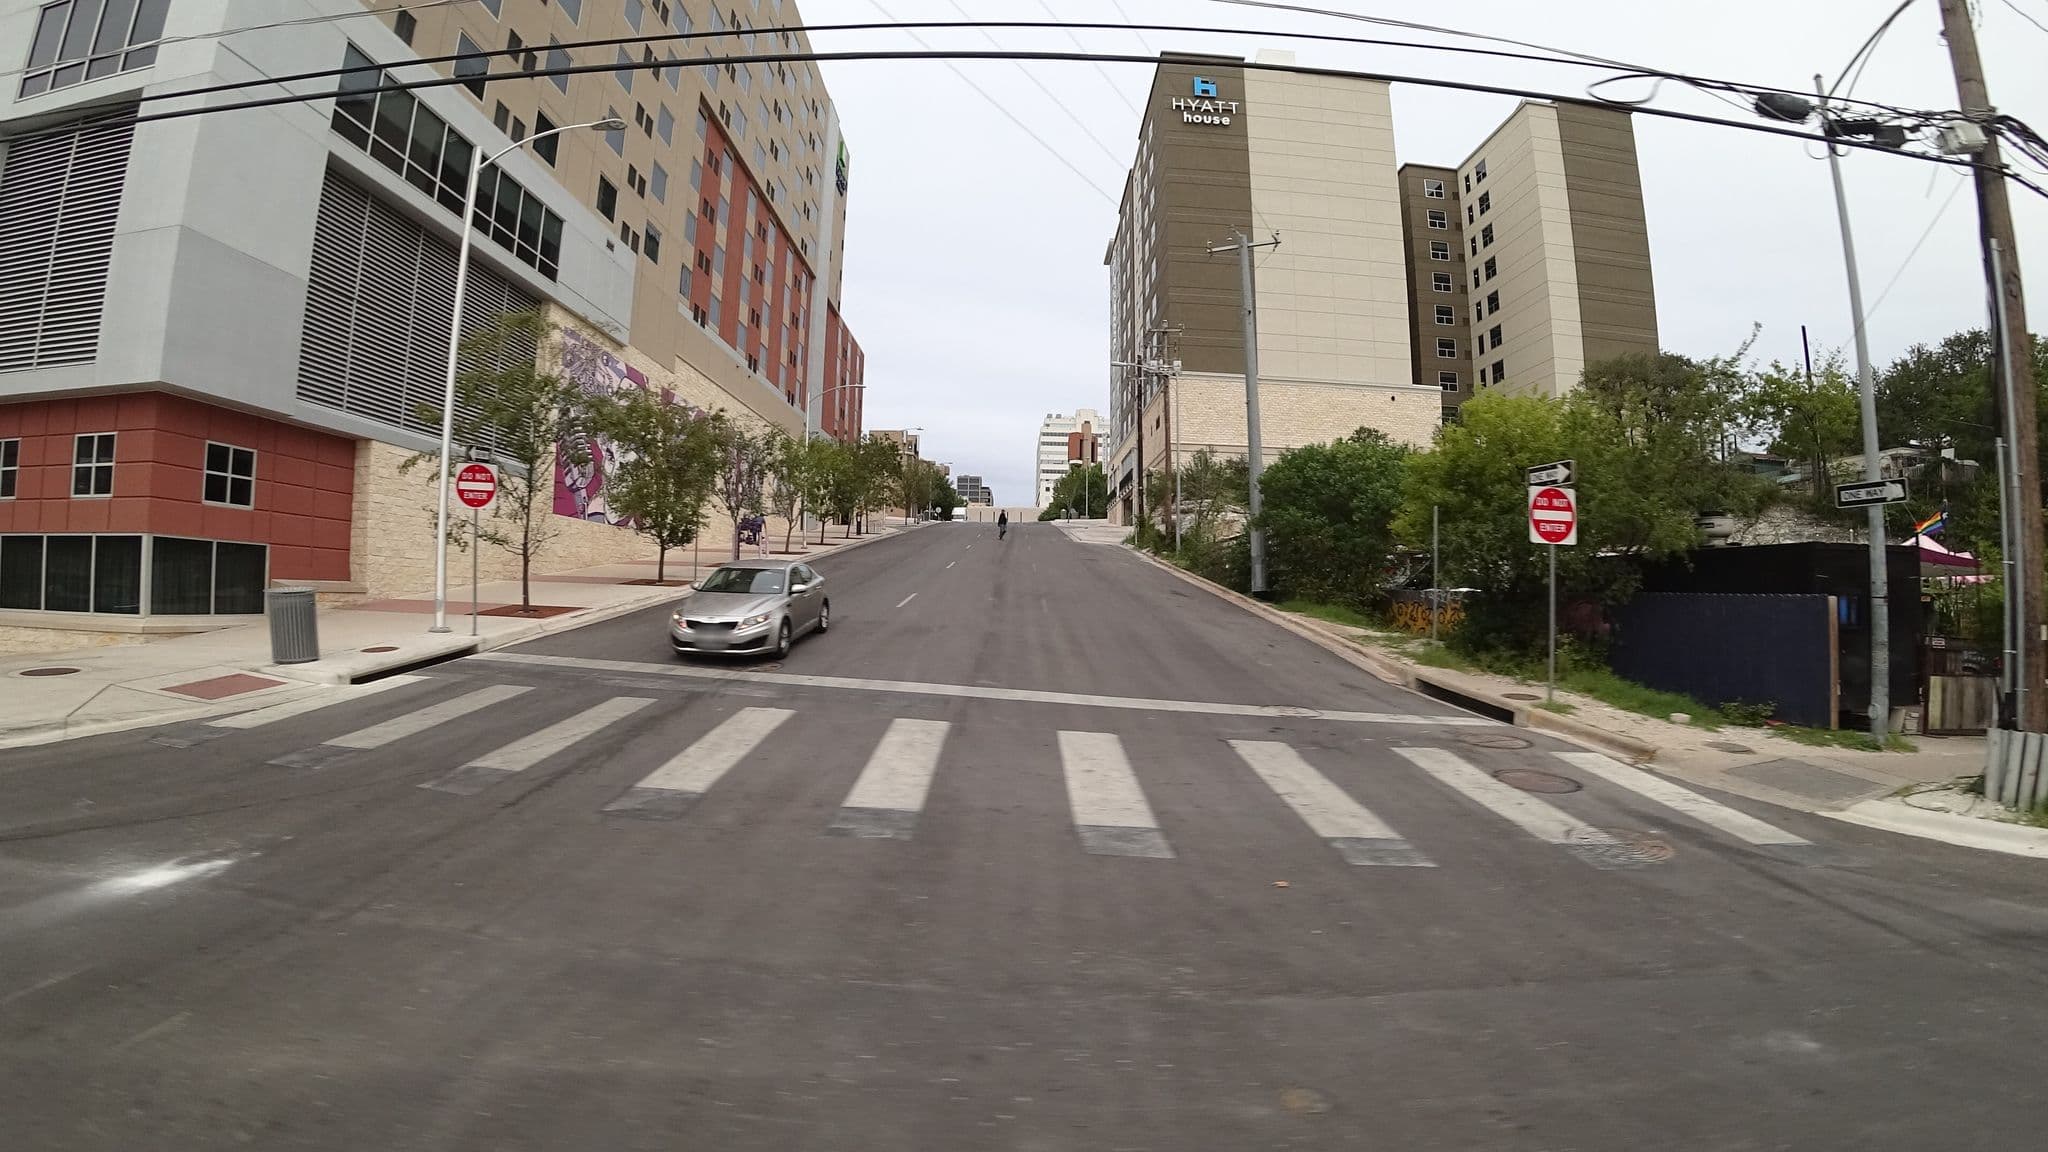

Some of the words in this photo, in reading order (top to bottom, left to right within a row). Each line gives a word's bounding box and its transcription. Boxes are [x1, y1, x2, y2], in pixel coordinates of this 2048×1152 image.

[1172, 97, 1240, 115] HYATT
[1183, 111, 1231, 125] house
[461, 472, 474, 480] DO
[463, 491, 488, 500] ENTER
[1843, 489, 1862, 500] ONE
[1865, 487, 1885, 498] WAY
[1535, 497, 1550, 506] DO
[1551, 498, 1569, 507] NOT
[1539, 523, 1567, 533] ENTER
